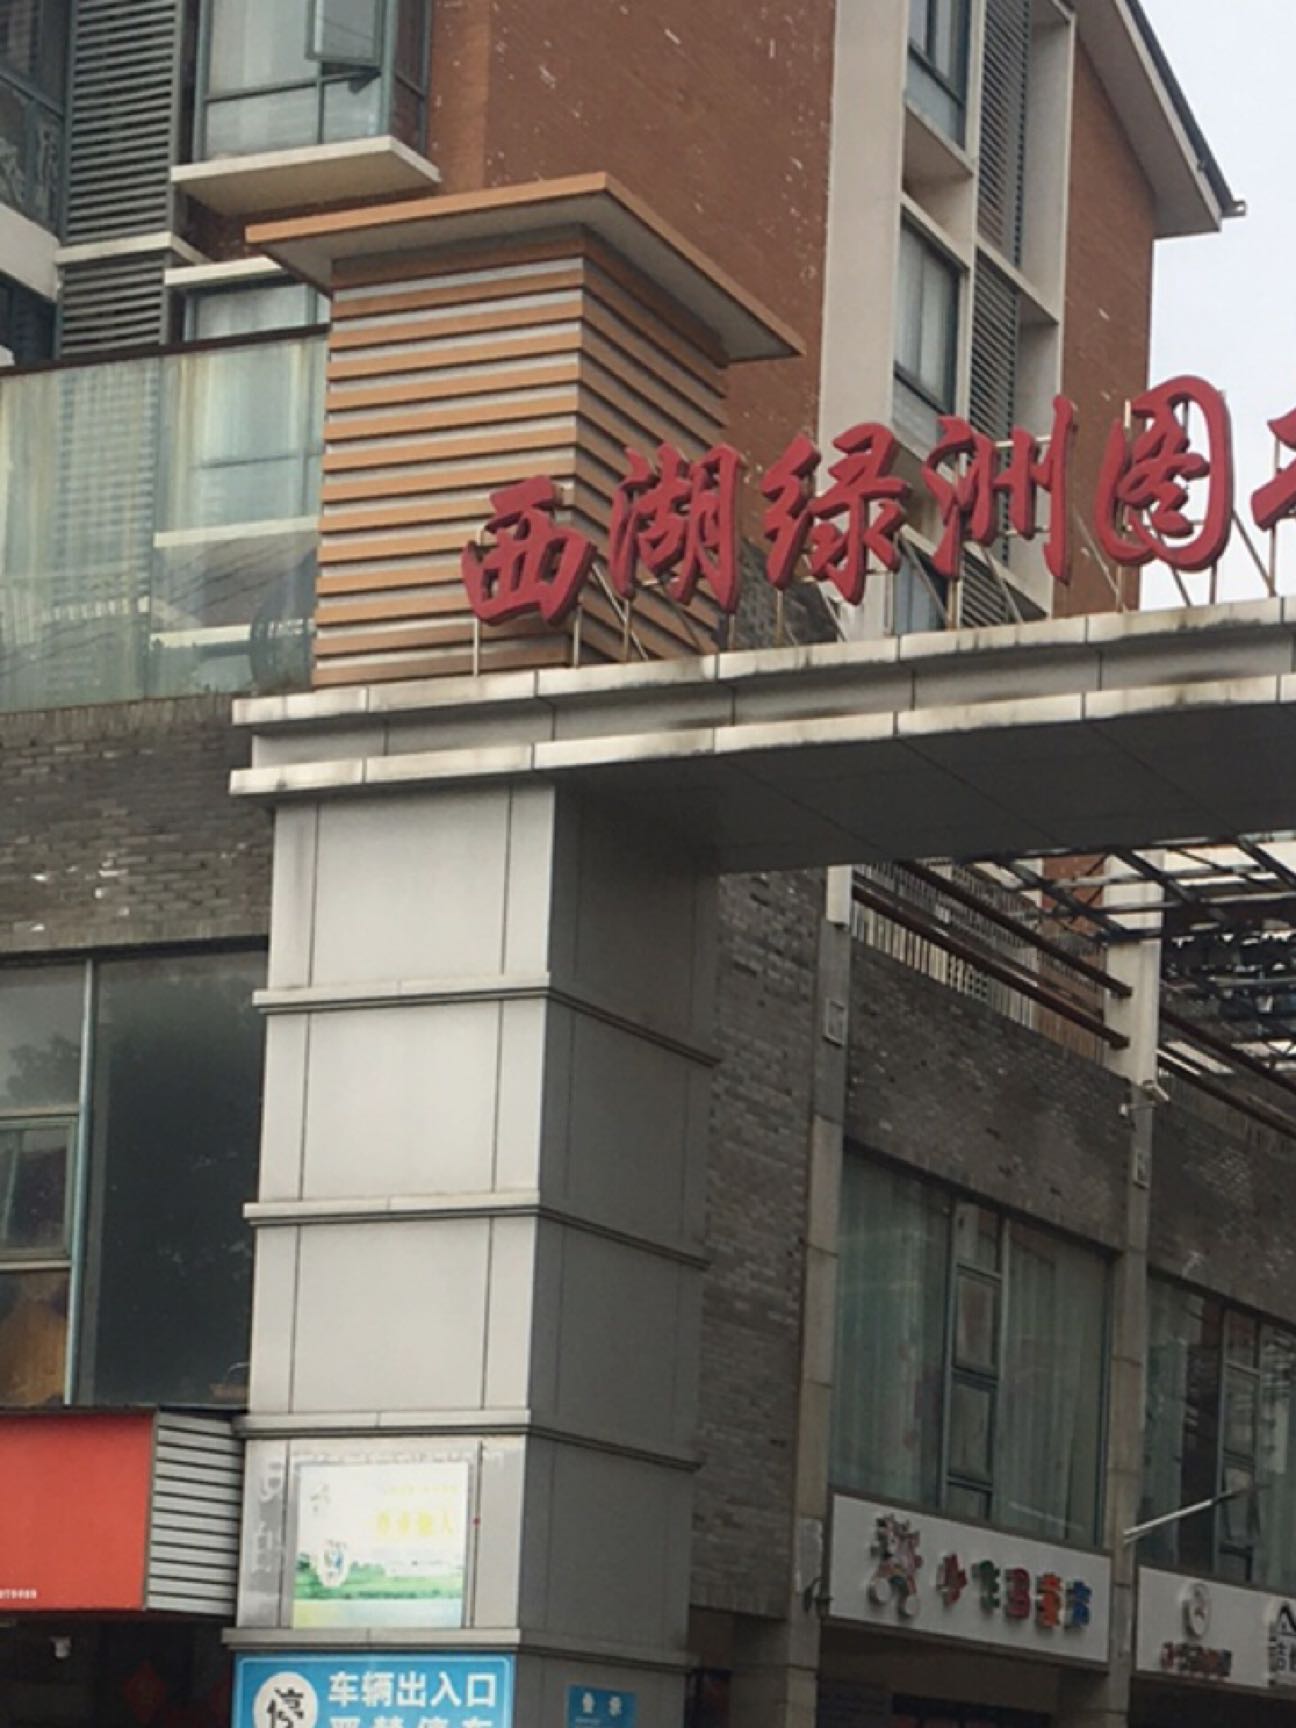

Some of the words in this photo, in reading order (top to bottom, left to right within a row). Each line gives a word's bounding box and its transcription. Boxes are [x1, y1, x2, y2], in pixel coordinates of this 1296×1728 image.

[328, 1671, 497, 1708] 车辆出入口
